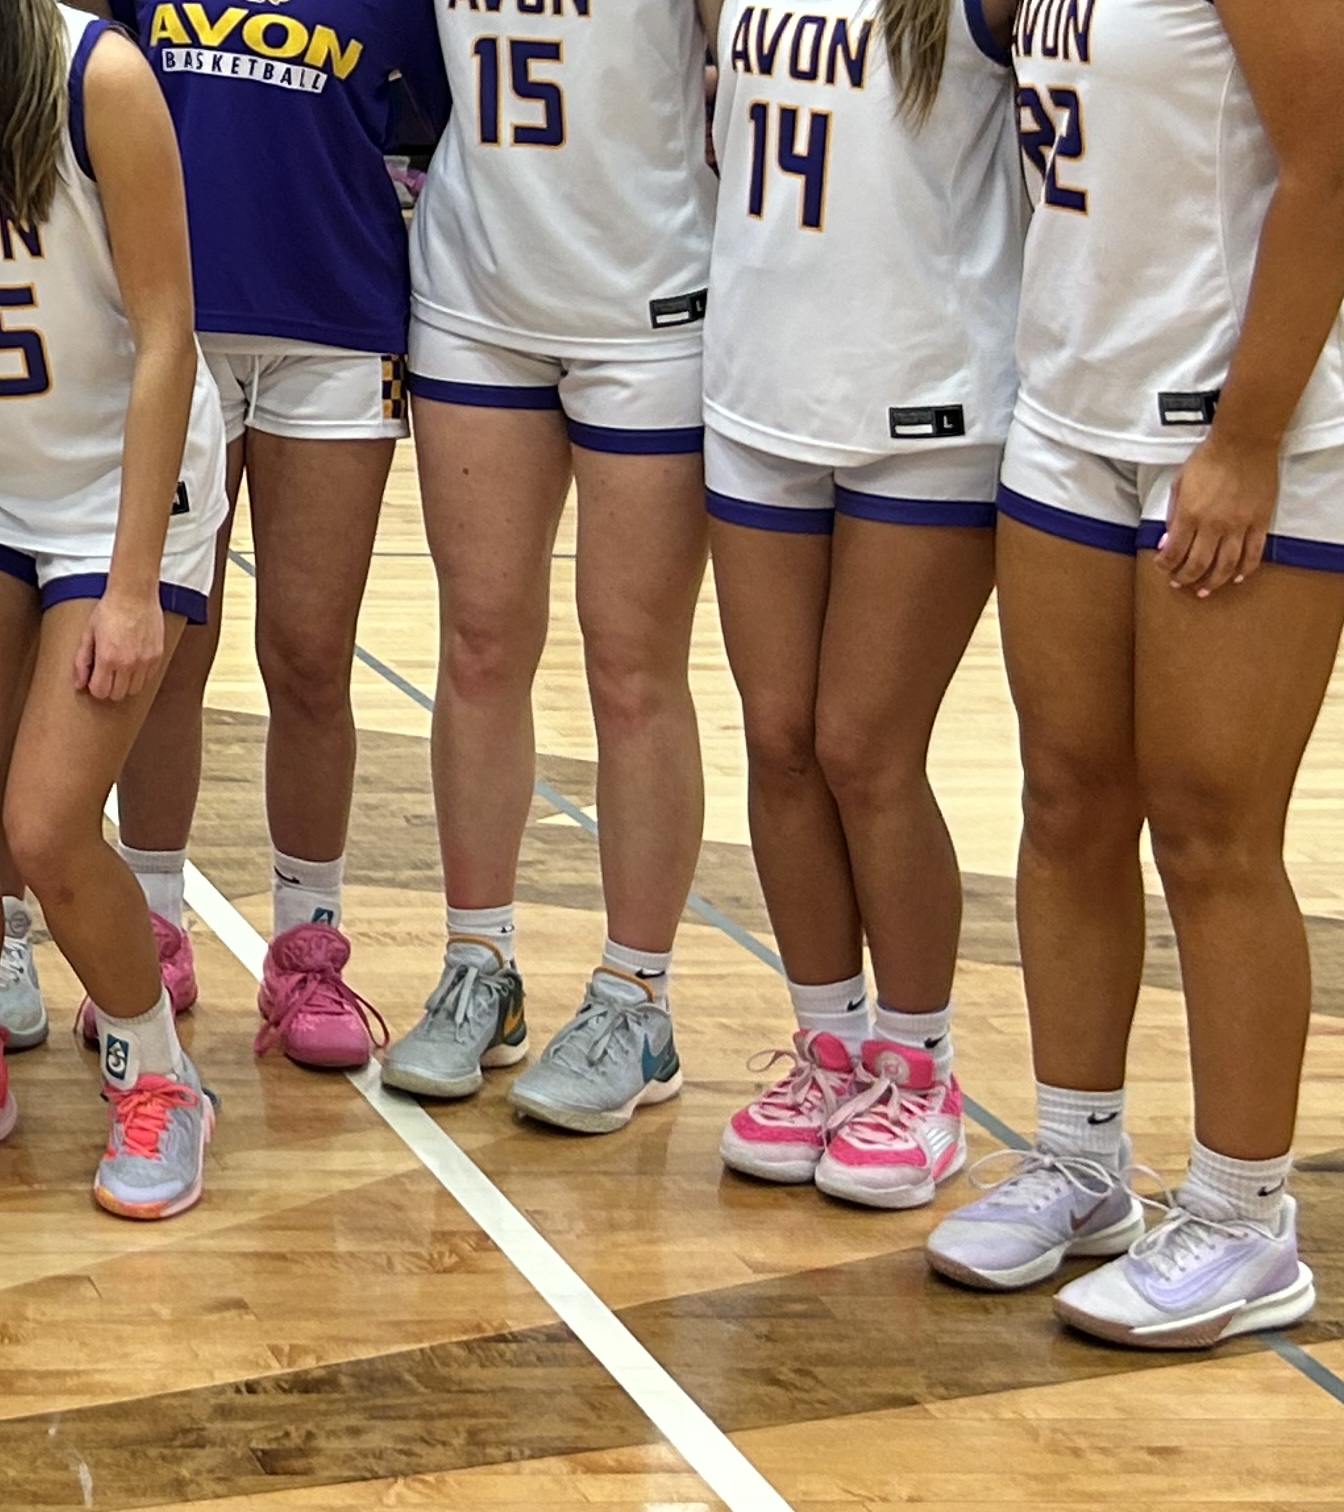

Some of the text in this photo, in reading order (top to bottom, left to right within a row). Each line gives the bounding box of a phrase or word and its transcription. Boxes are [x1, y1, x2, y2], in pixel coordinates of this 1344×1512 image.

[150, 3, 363, 80] AVON
[165, 51, 322, 90] BASKETBALL
[732, 5, 875, 90] AVON
[472, 34, 567, 149] 15
[746, 98, 832, 232] 14
